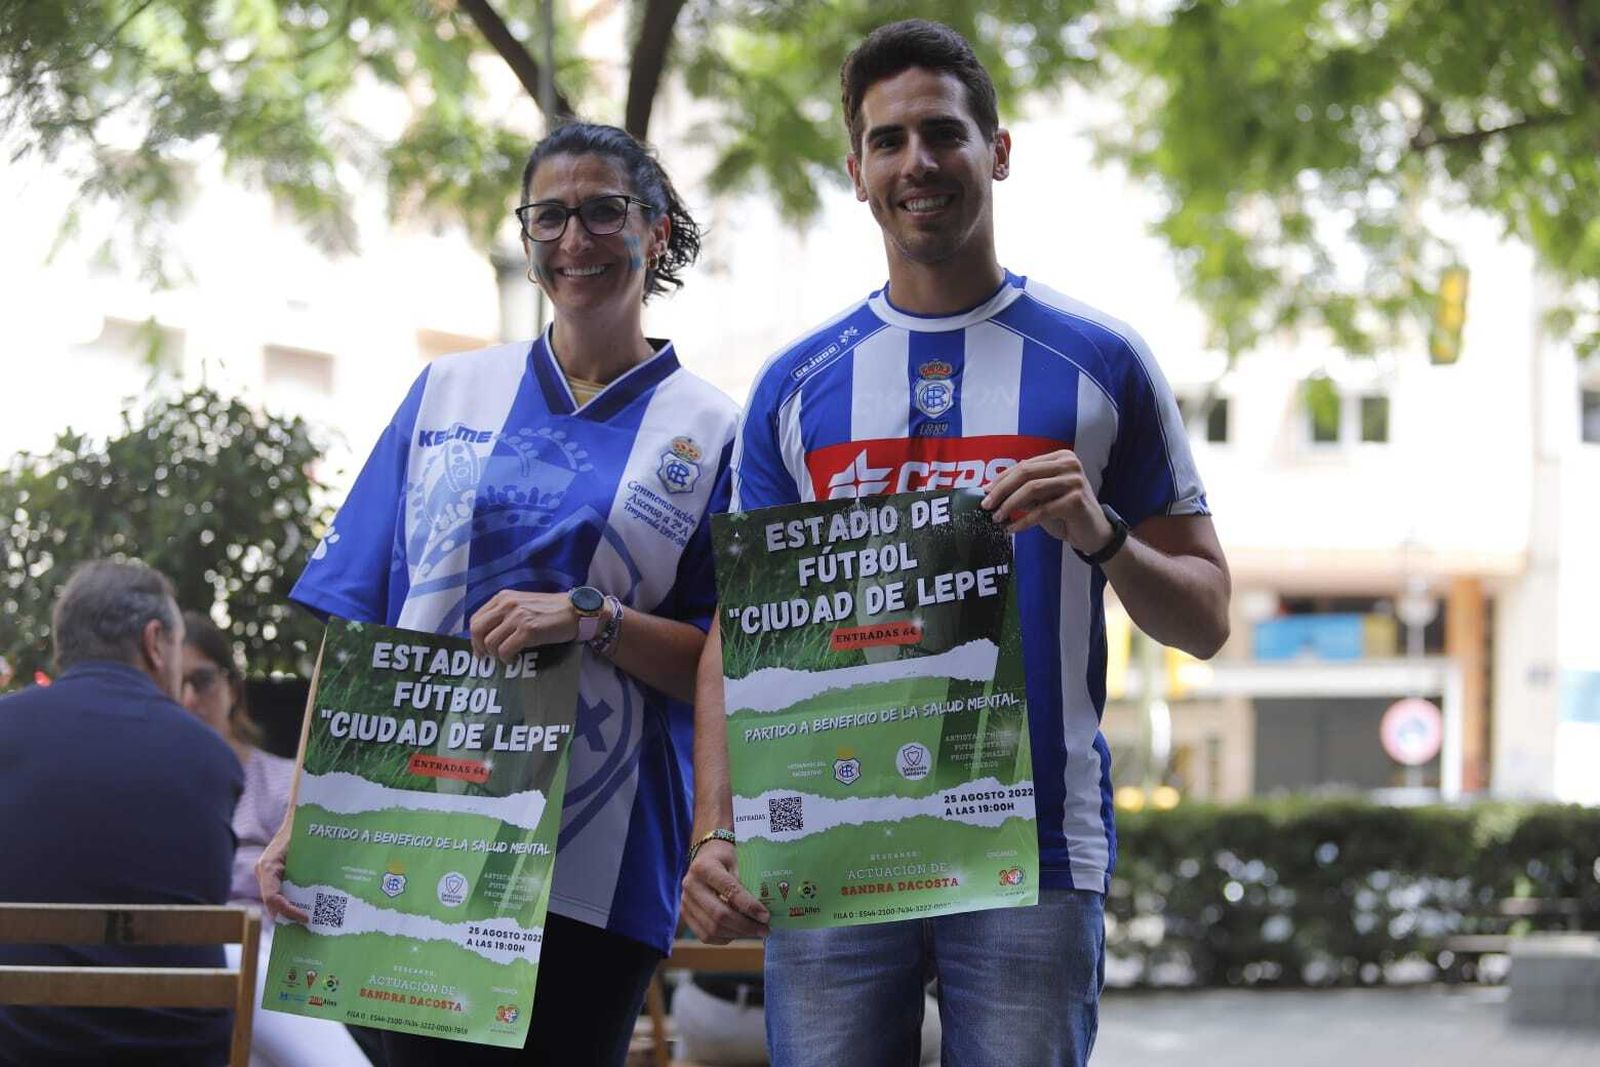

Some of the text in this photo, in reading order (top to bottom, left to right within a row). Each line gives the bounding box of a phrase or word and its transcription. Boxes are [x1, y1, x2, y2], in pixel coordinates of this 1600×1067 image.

[418, 426, 493, 447] KELME
[896, 457, 1018, 494] CEPS
[628, 493, 663, 519] Ascenso
[765, 496, 951, 552] ESTADIO DE
[799, 542, 918, 587] FÚTBOL
[729, 564, 1009, 634] "CIUDAD DE LEPE"
[836, 628, 899, 643] ENTRADAS
[372, 642, 539, 679] ESTADIO DE
[393, 675, 502, 714] FÚTBOL
[745, 692, 1020, 742] PARTIDO A BENEFICIO DE LA SALUD MENTAL
[321, 709, 570, 752] "CIUDAD DE LEPE"
[413, 759, 470, 774] ENTRADAS
[944, 788, 1034, 804] 25 AGOSTO 2022
[945, 802, 1015, 816] A LAS 19:00H
[309, 823, 552, 856] PARTIDO A BENEFICIO DE LA SALUD MENTAL
[931, 861, 949, 874] DE
[841, 877, 959, 896] SANDRA DACOSTA
[466, 938, 525, 952] A LAS 19:00H
[468, 926, 480, 935] 25
[482, 928, 520, 940] AGOSTO
[359, 987, 462, 1012] SANDRA DACOSTA
